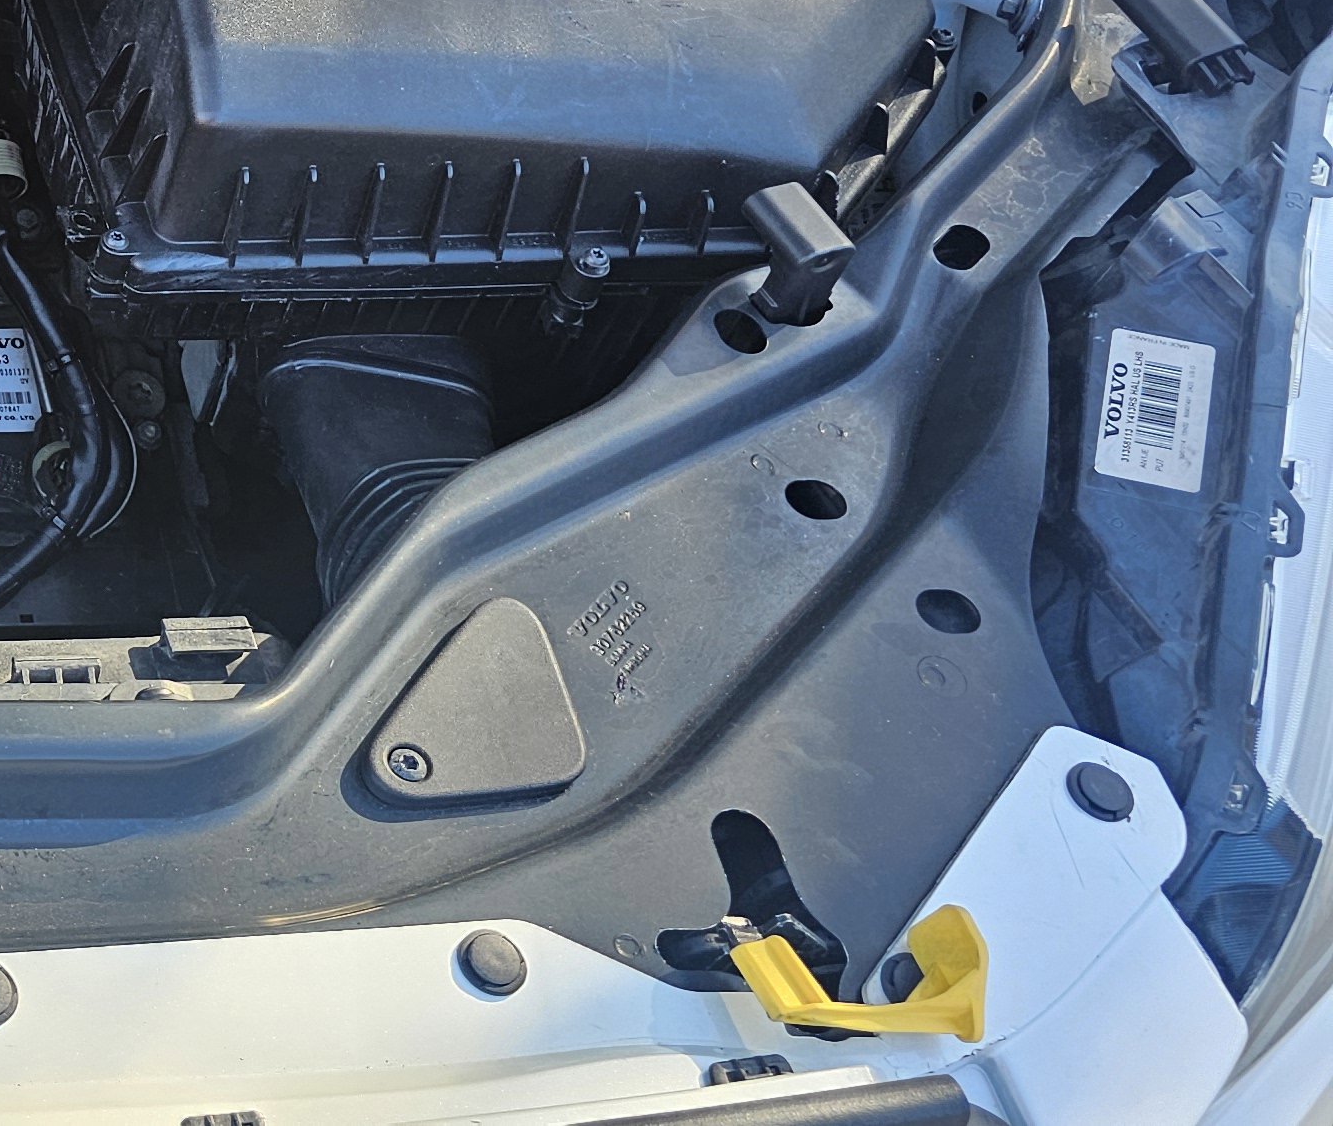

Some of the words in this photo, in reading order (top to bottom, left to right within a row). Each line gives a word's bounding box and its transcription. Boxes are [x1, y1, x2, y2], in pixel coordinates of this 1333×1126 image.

[1134, 351, 1144, 367] LHS
[1132, 367, 1142, 379] US
[1130, 380, 1140, 396] HAL
[1104, 362, 1128, 439] VOLVO
